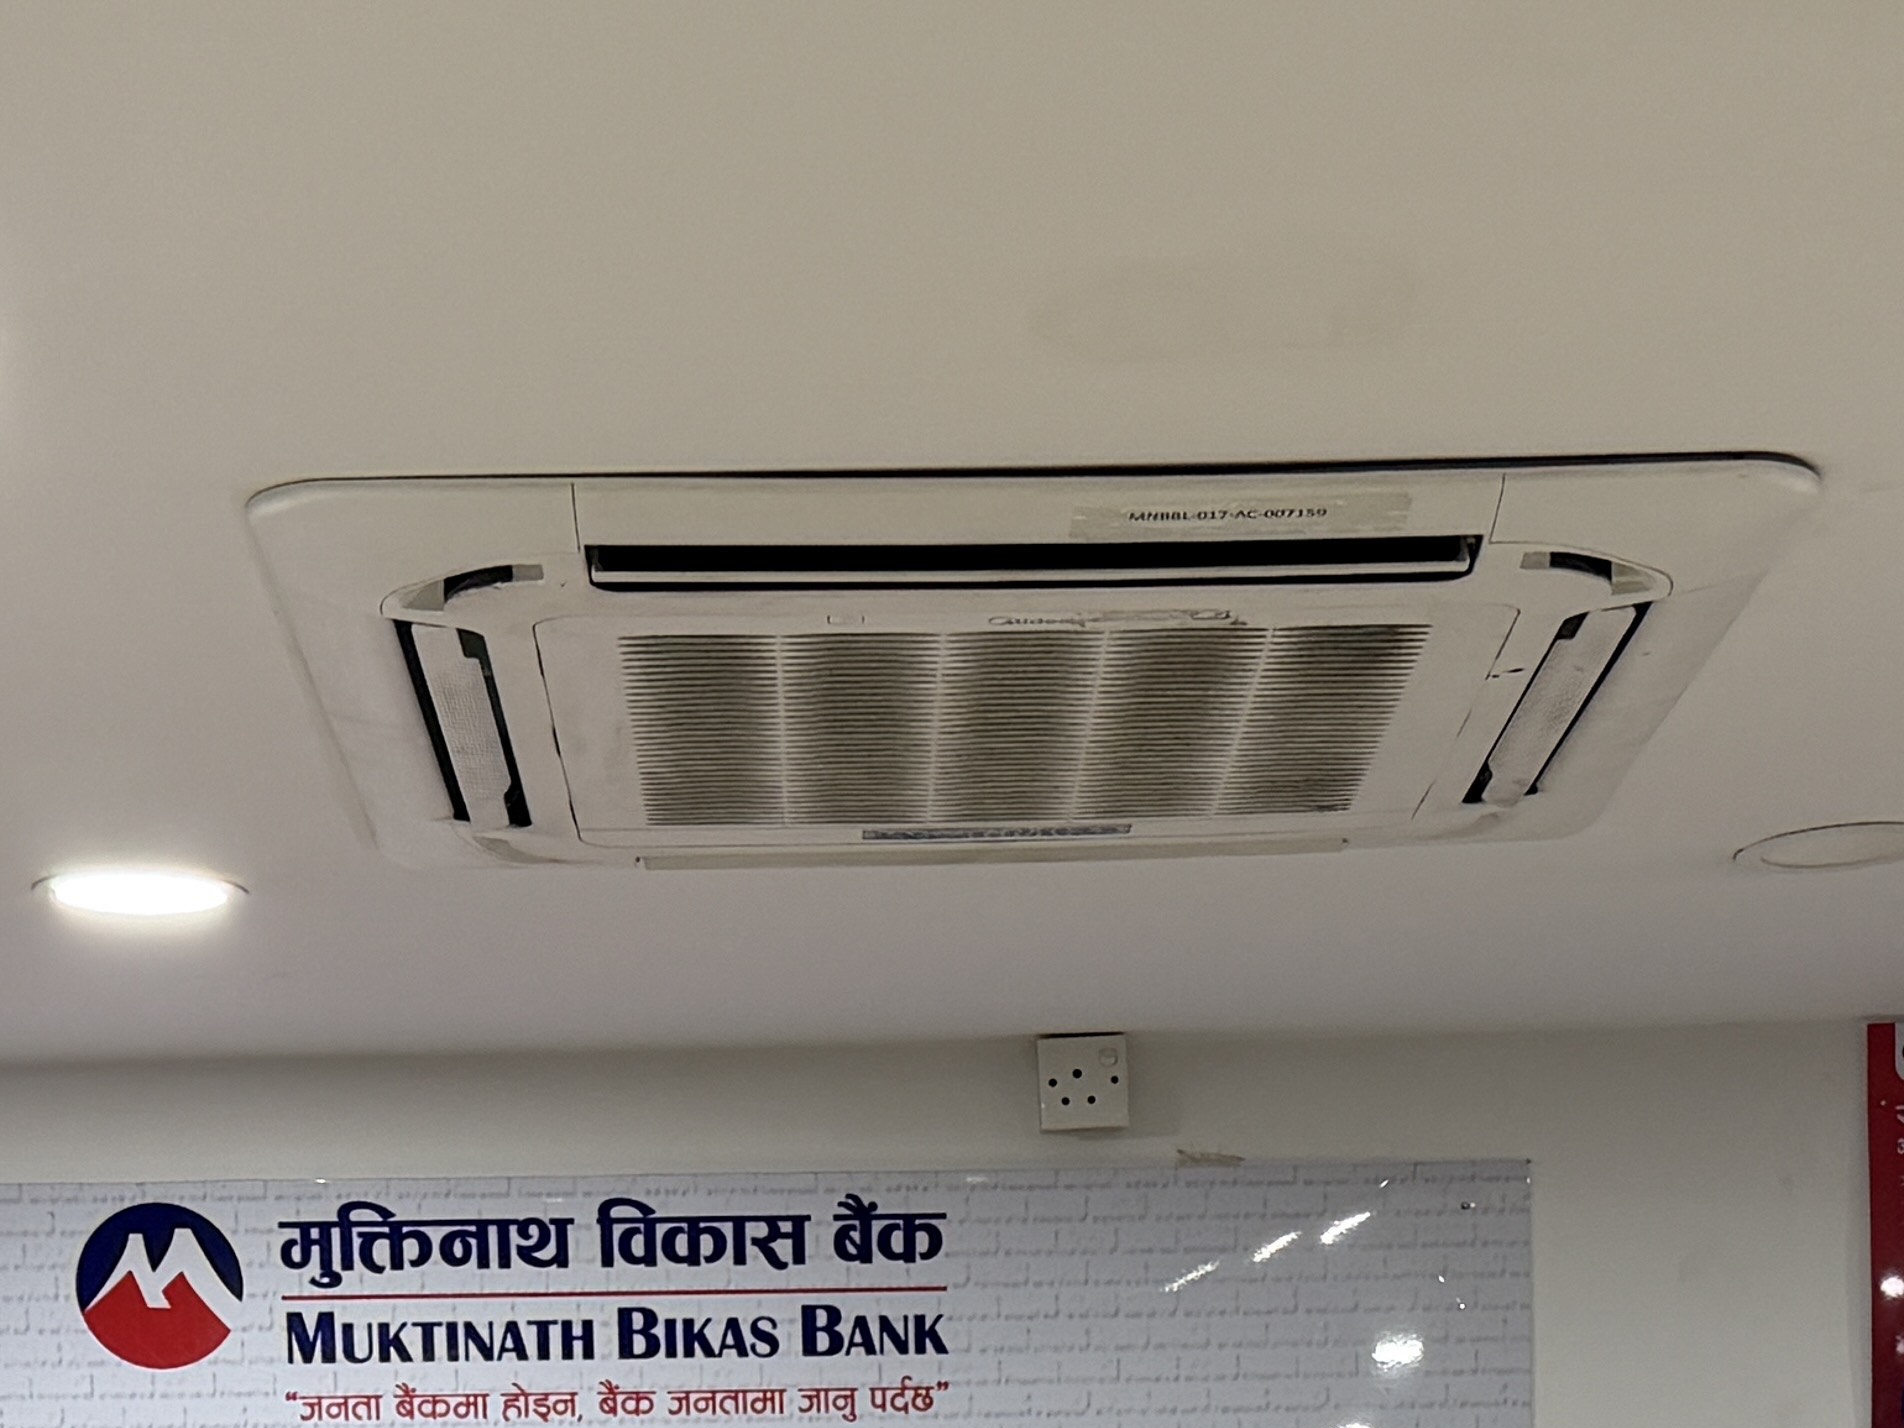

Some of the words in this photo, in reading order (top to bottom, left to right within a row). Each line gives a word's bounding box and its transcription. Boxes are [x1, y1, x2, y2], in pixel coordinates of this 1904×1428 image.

[278, 1200, 574, 1288] मुक्तिनाथ
[597, 1198, 811, 1271] विकास
[833, 1193, 947, 1267] बैंक
[286, 1311, 595, 1364] MUKTINATH
[617, 1306, 780, 1359] BIKAS
[800, 1304, 949, 1356] BANK
[394, 1384, 488, 1420] बैंकमा
[597, 1380, 655, 1417] बैंक
[668, 1387, 786, 1419] जनतामा
[798, 1387, 858, 1422] जानु
